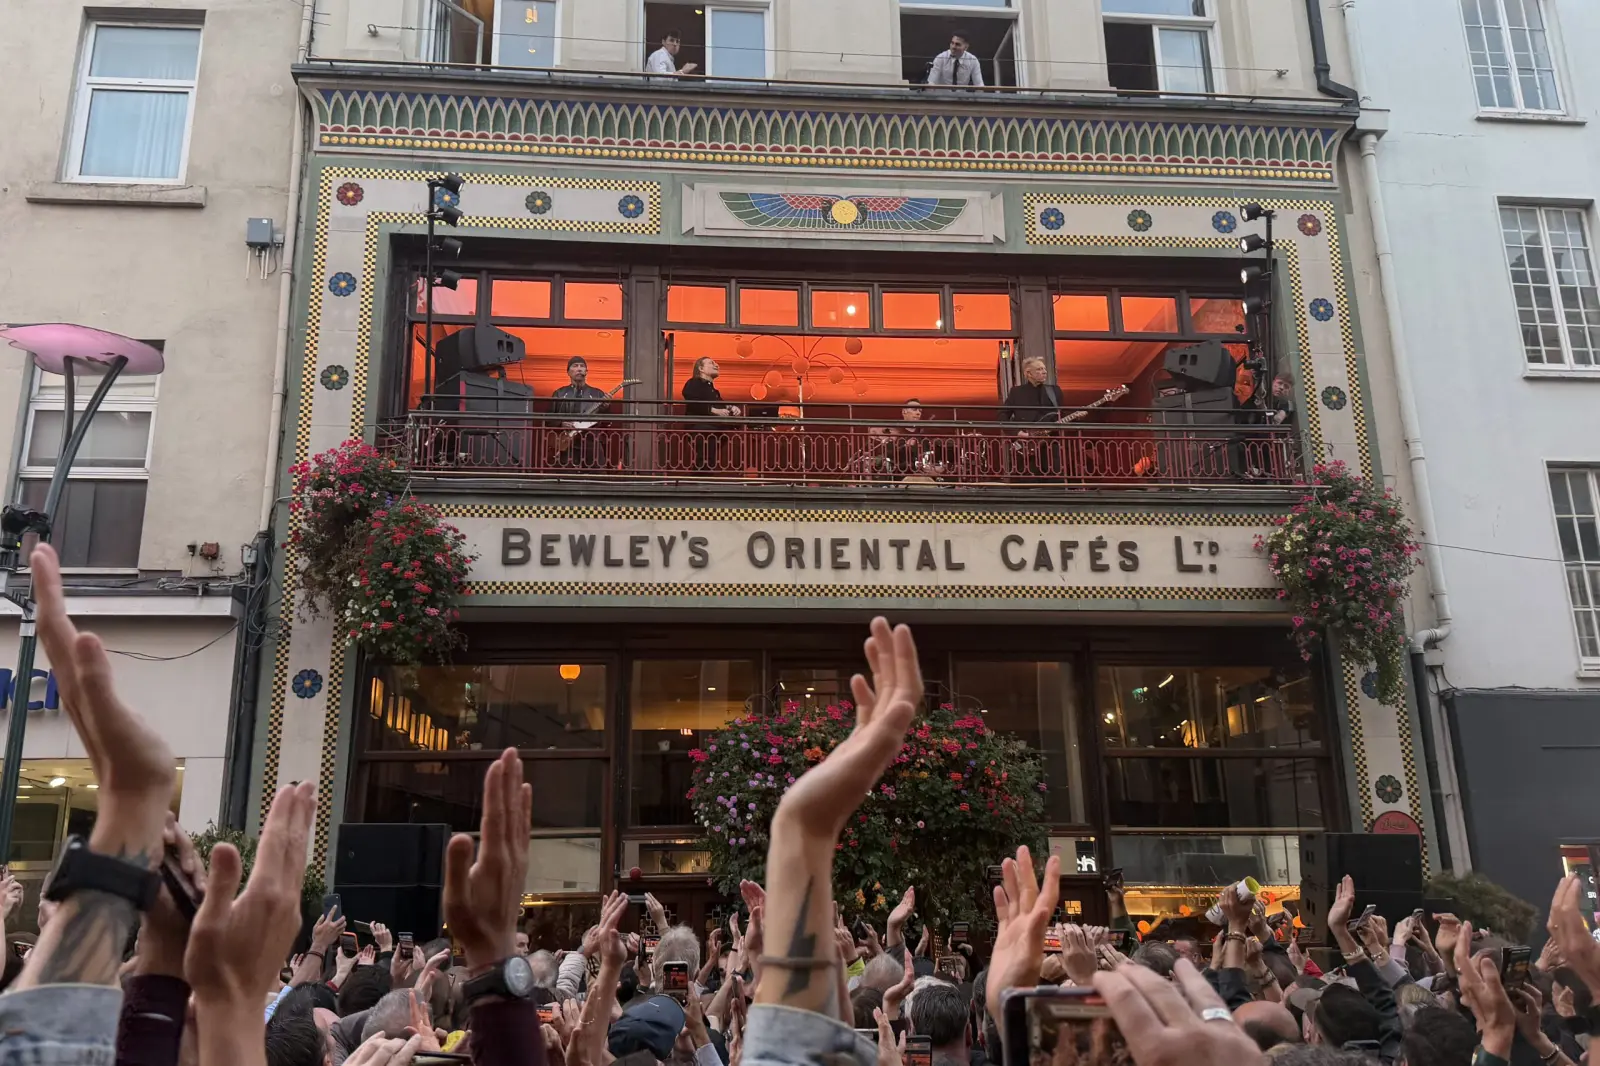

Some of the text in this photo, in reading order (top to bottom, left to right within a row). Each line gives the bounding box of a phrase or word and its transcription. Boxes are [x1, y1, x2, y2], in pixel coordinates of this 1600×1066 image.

[502, 528, 709, 568] BEWLEY'S
[747, 531, 965, 570] ORIENTAL
[1001, 534, 1139, 572] CAFÉS
